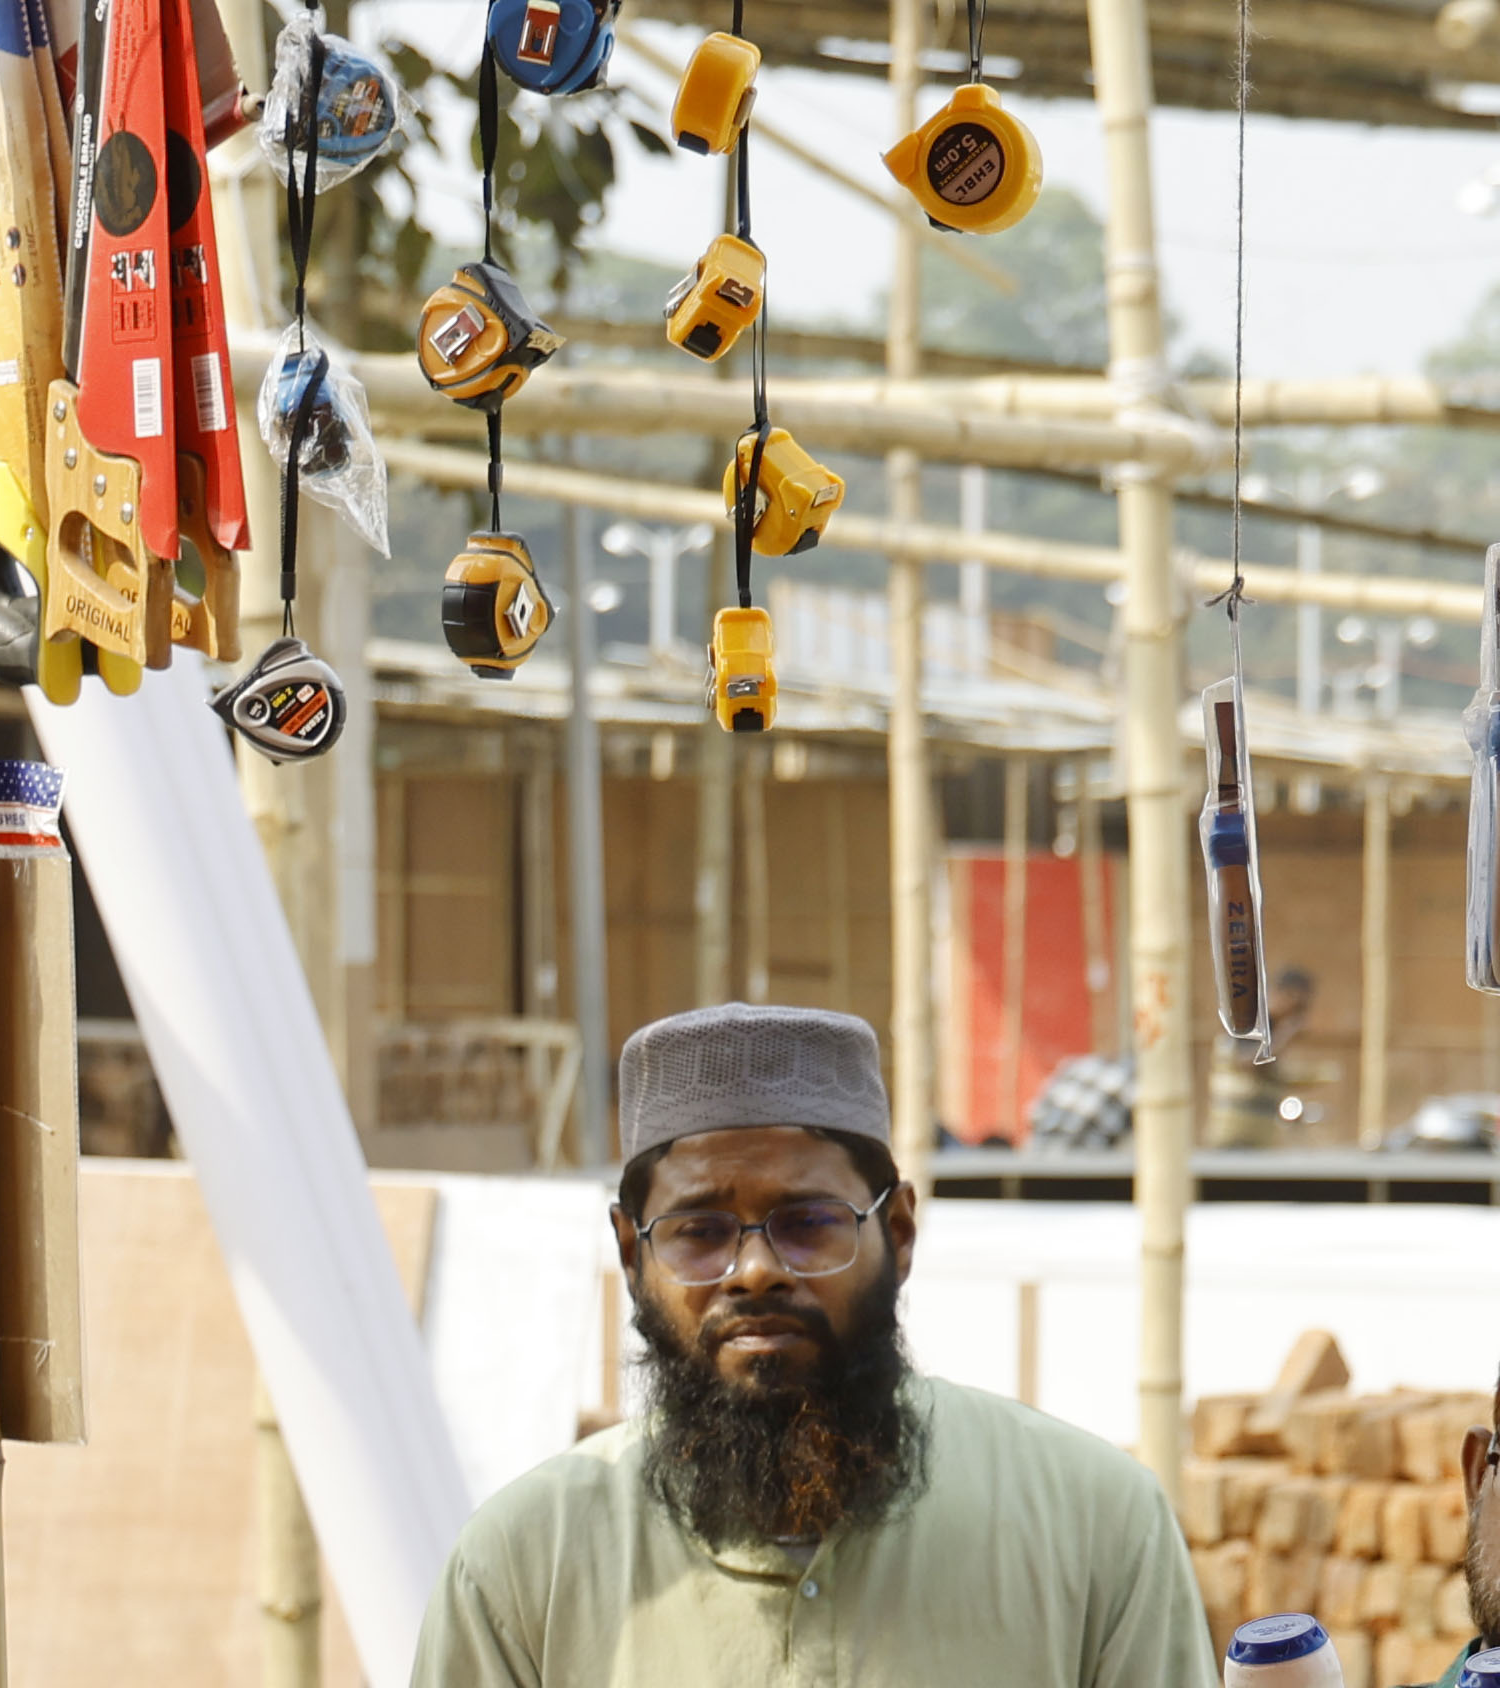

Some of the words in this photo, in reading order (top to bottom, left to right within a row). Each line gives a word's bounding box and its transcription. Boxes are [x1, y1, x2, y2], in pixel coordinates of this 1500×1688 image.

[81, 113, 93, 168] BRAND
[934, 134, 978, 173] 5.0m
[955, 159, 996, 197] EHBL
[74, 171, 89, 249] CROCODILE
[66, 595, 131, 644] ORIGINAL
